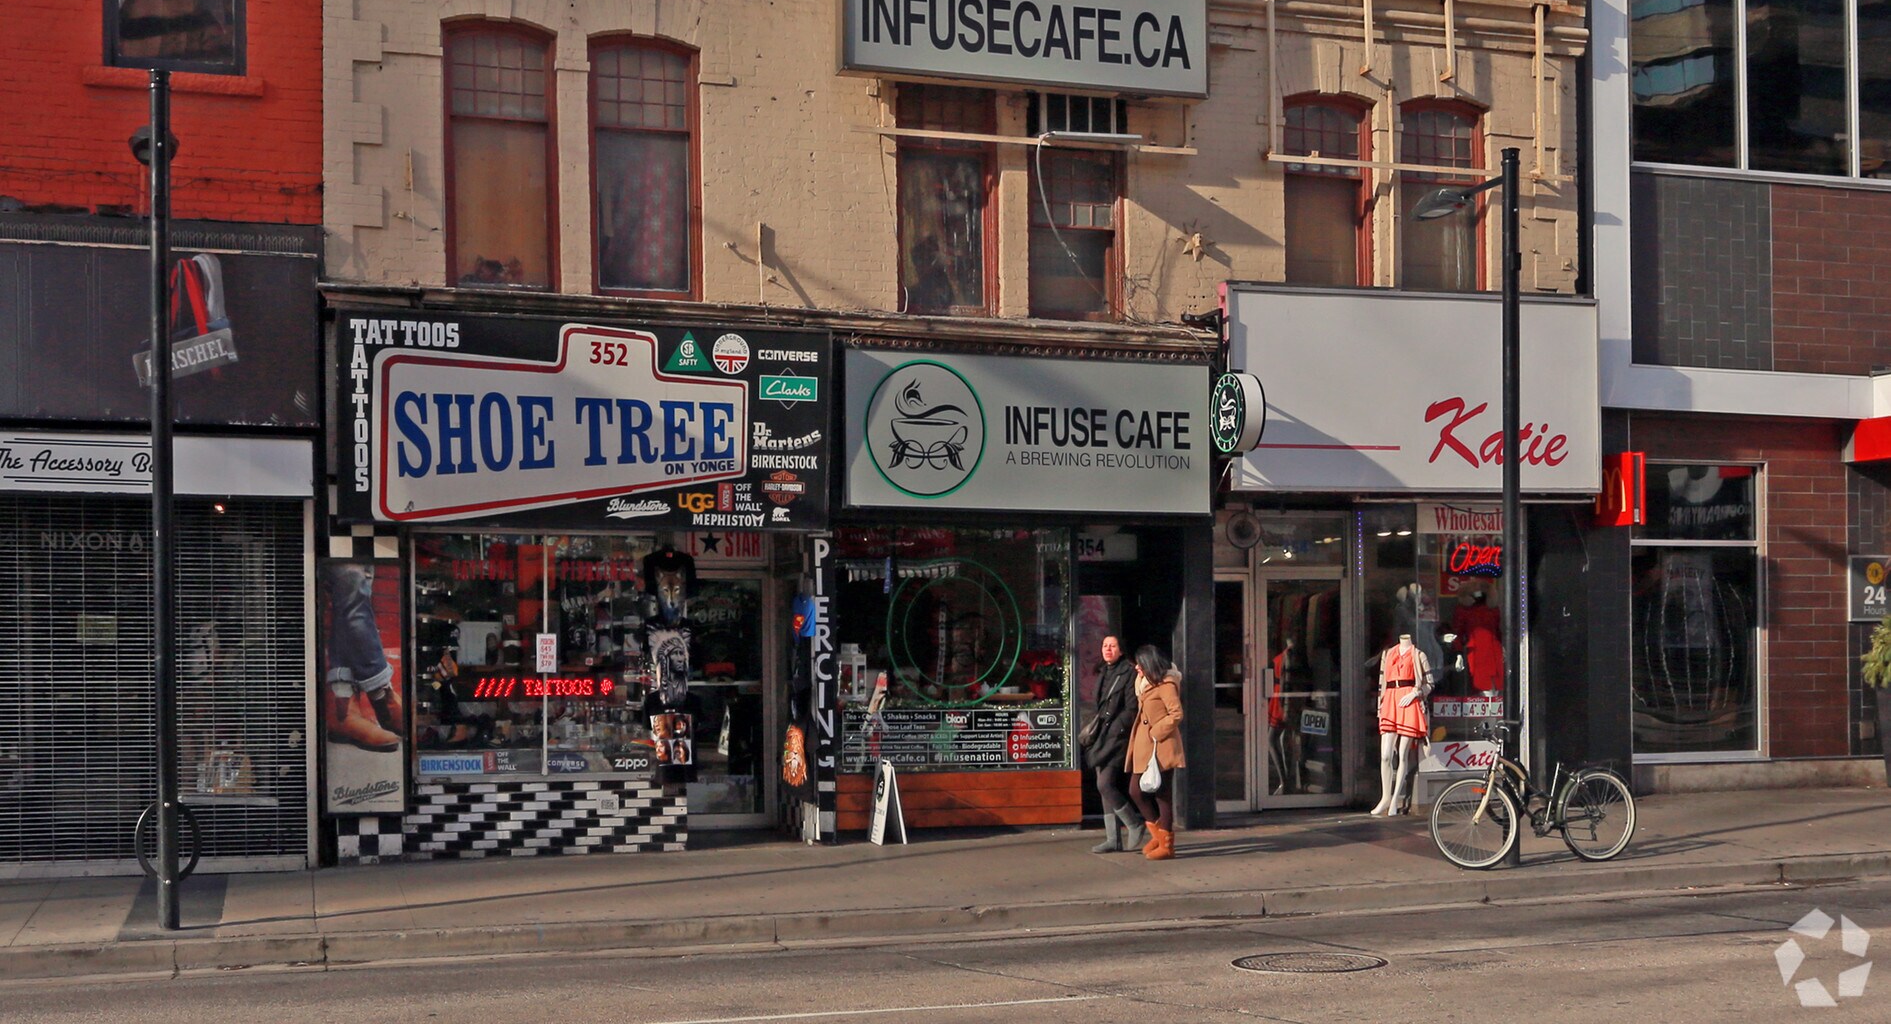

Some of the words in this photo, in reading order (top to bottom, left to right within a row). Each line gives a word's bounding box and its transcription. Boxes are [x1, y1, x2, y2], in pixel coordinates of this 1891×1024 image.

[350, 319, 459, 348] TATTOOS
[589, 342, 628, 367] 352
[679, 358, 698, 366] SAFTY
[758, 349, 818, 362] CONVERSE
[766, 380, 811, 396] Clarks
[394, 391, 555, 478] SHOE
[575, 398, 735, 466] TREE
[1005, 405, 1108, 447] INFUSE
[1115, 410, 1191, 450] CAFE
[753, 429, 822, 450] Martens
[30, 450, 123, 476] Accessory
[665, 463, 684, 475] ON
[691, 460, 735, 474] YONGE
[752, 455, 818, 470] BIRKENSTOCK
[1006, 452, 1017, 465] A
[1020, 452, 1091, 468] BREWING
[1096, 453, 1191, 470] REVOLUTION
[607, 497, 669, 512] Blundstone
[678, 492, 715, 513] UGG
[736, 493, 752, 501] THE
[1434, 507, 1504, 531] Wholesal
[40, 532, 122, 551] NIXON
[725, 532, 761, 557] STAR
[1450, 542, 1502, 572] Open
[1864, 586, 1886, 605] 24
[698, 608, 737, 624] OPEN
[1864, 605, 1888, 615] Hours
[814, 539, 834, 769] PIERCING
[522, 679, 595, 696] TATTOOS
[1304, 714, 1326, 728] OPEN
[421, 758, 482, 772] BIRKENSTOCK
[614, 757, 648, 769] zippo
[846, 754, 926, 762] www.InfuseCafe.ca
[333, 780, 400, 801] Blundstone
